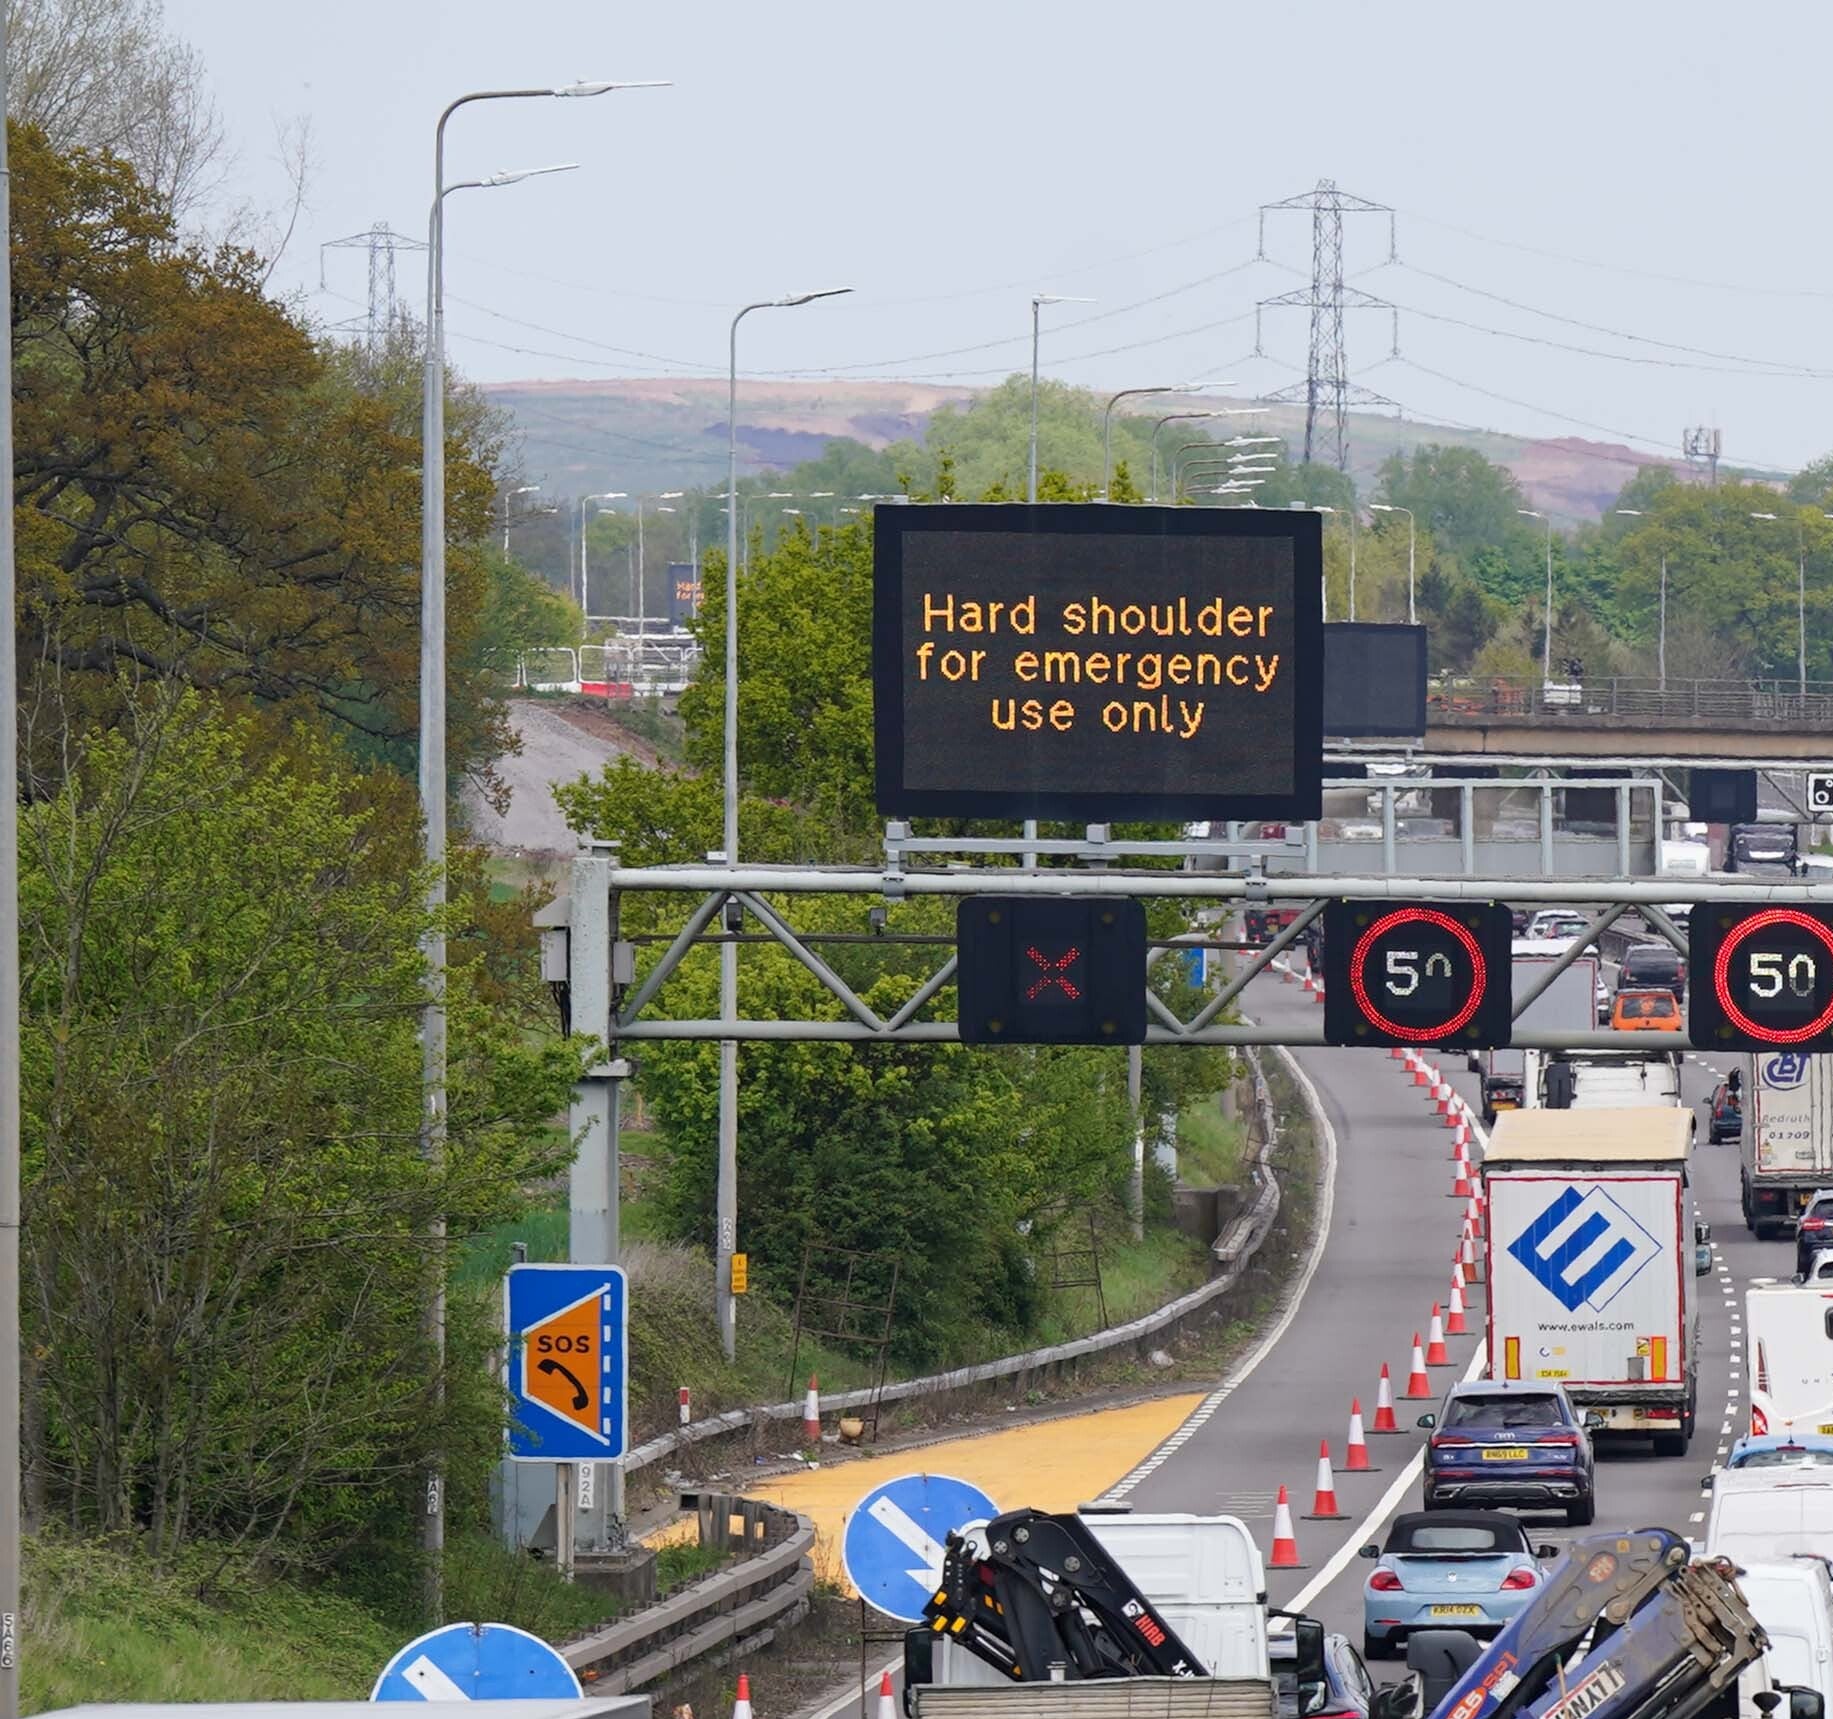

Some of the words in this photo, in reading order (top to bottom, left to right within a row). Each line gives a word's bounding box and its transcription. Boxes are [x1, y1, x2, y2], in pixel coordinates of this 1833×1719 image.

[923, 593, 1035, 635] Hard
[1063, 593, 1273, 636] shoulder
[917, 642, 986, 681] for
[1015, 648, 1279, 691] emergency
[992, 698, 1075, 731] use
[1103, 694, 1205, 739] only
[1750, 953, 1816, 997] 50
[537, 1335, 590, 1354] SOS
[1538, 1322, 1634, 1333] www.ewals.com
[581, 1466, 592, 1505] 92A
[1135, 1614, 1166, 1648] HIAB
